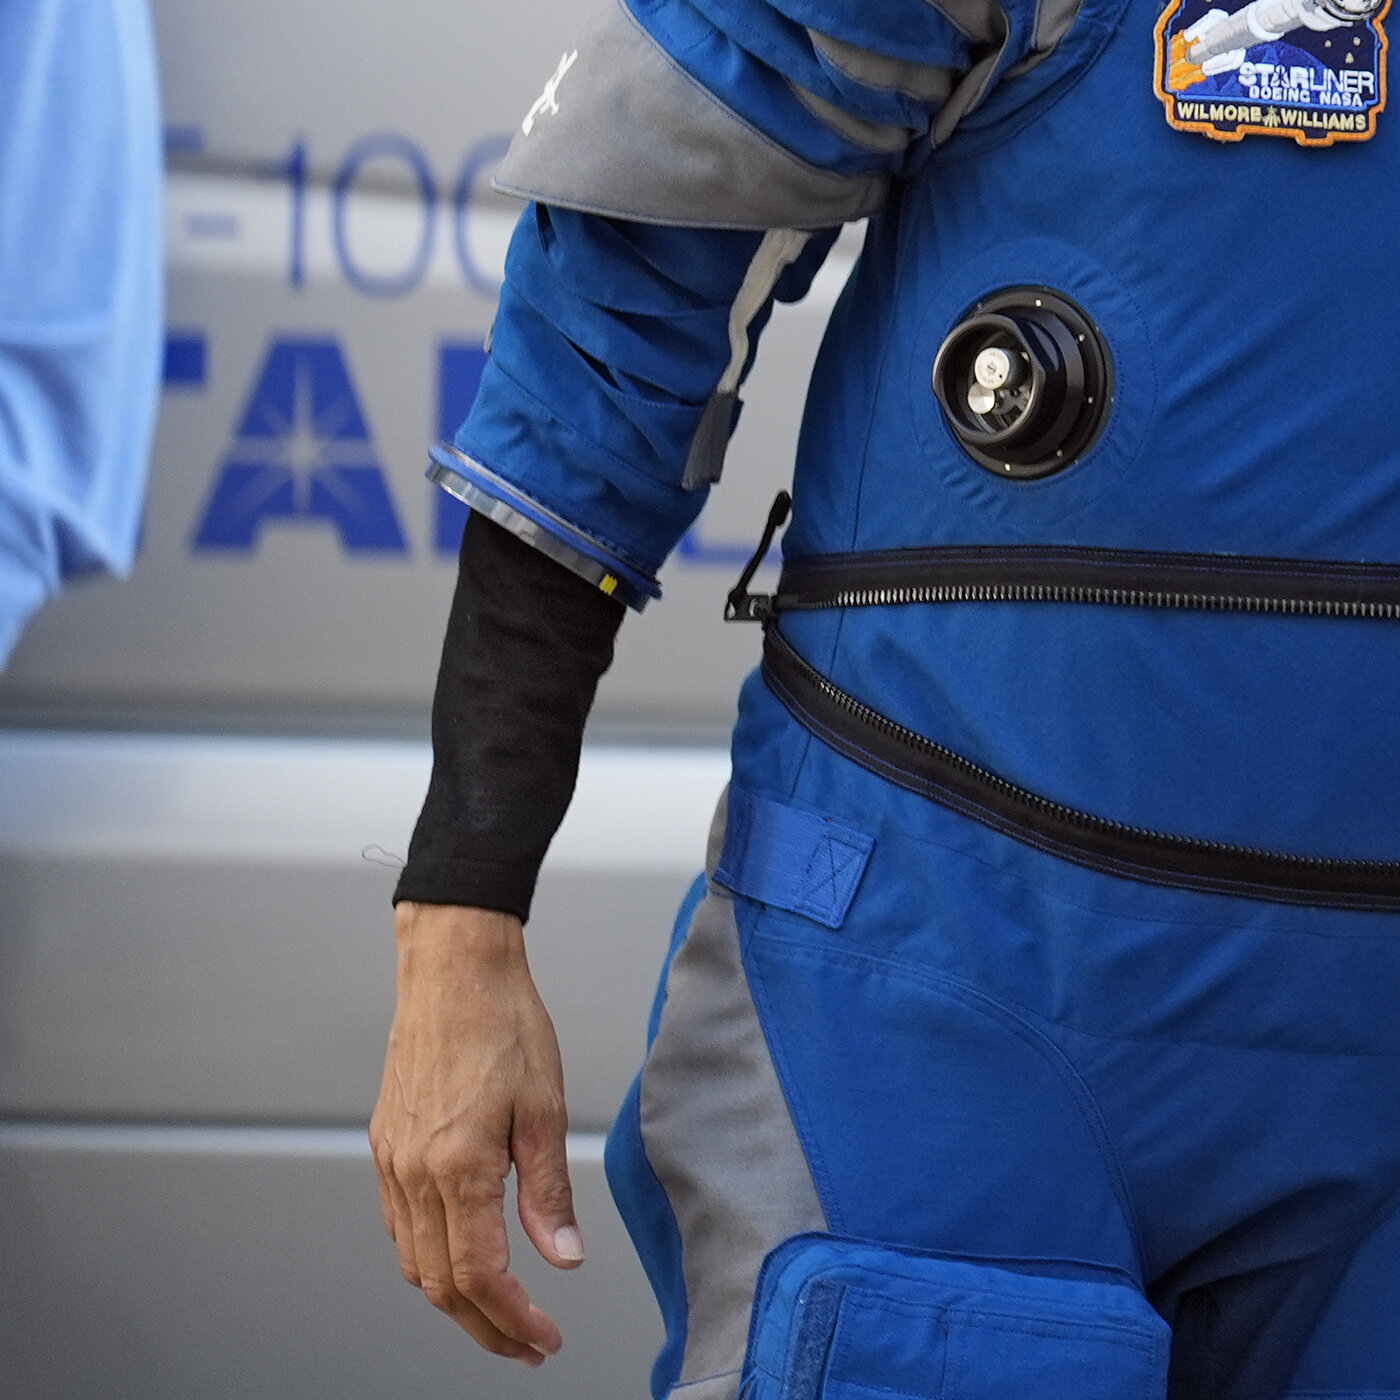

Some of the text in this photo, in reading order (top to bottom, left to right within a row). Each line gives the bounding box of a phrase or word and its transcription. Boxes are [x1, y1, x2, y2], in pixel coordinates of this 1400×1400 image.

[1238, 61, 1375, 95] STARLINER
[1249, 86, 1363, 107] BOEING NASA
[1177, 101, 1367, 131] WILMORE WILLIAMS
